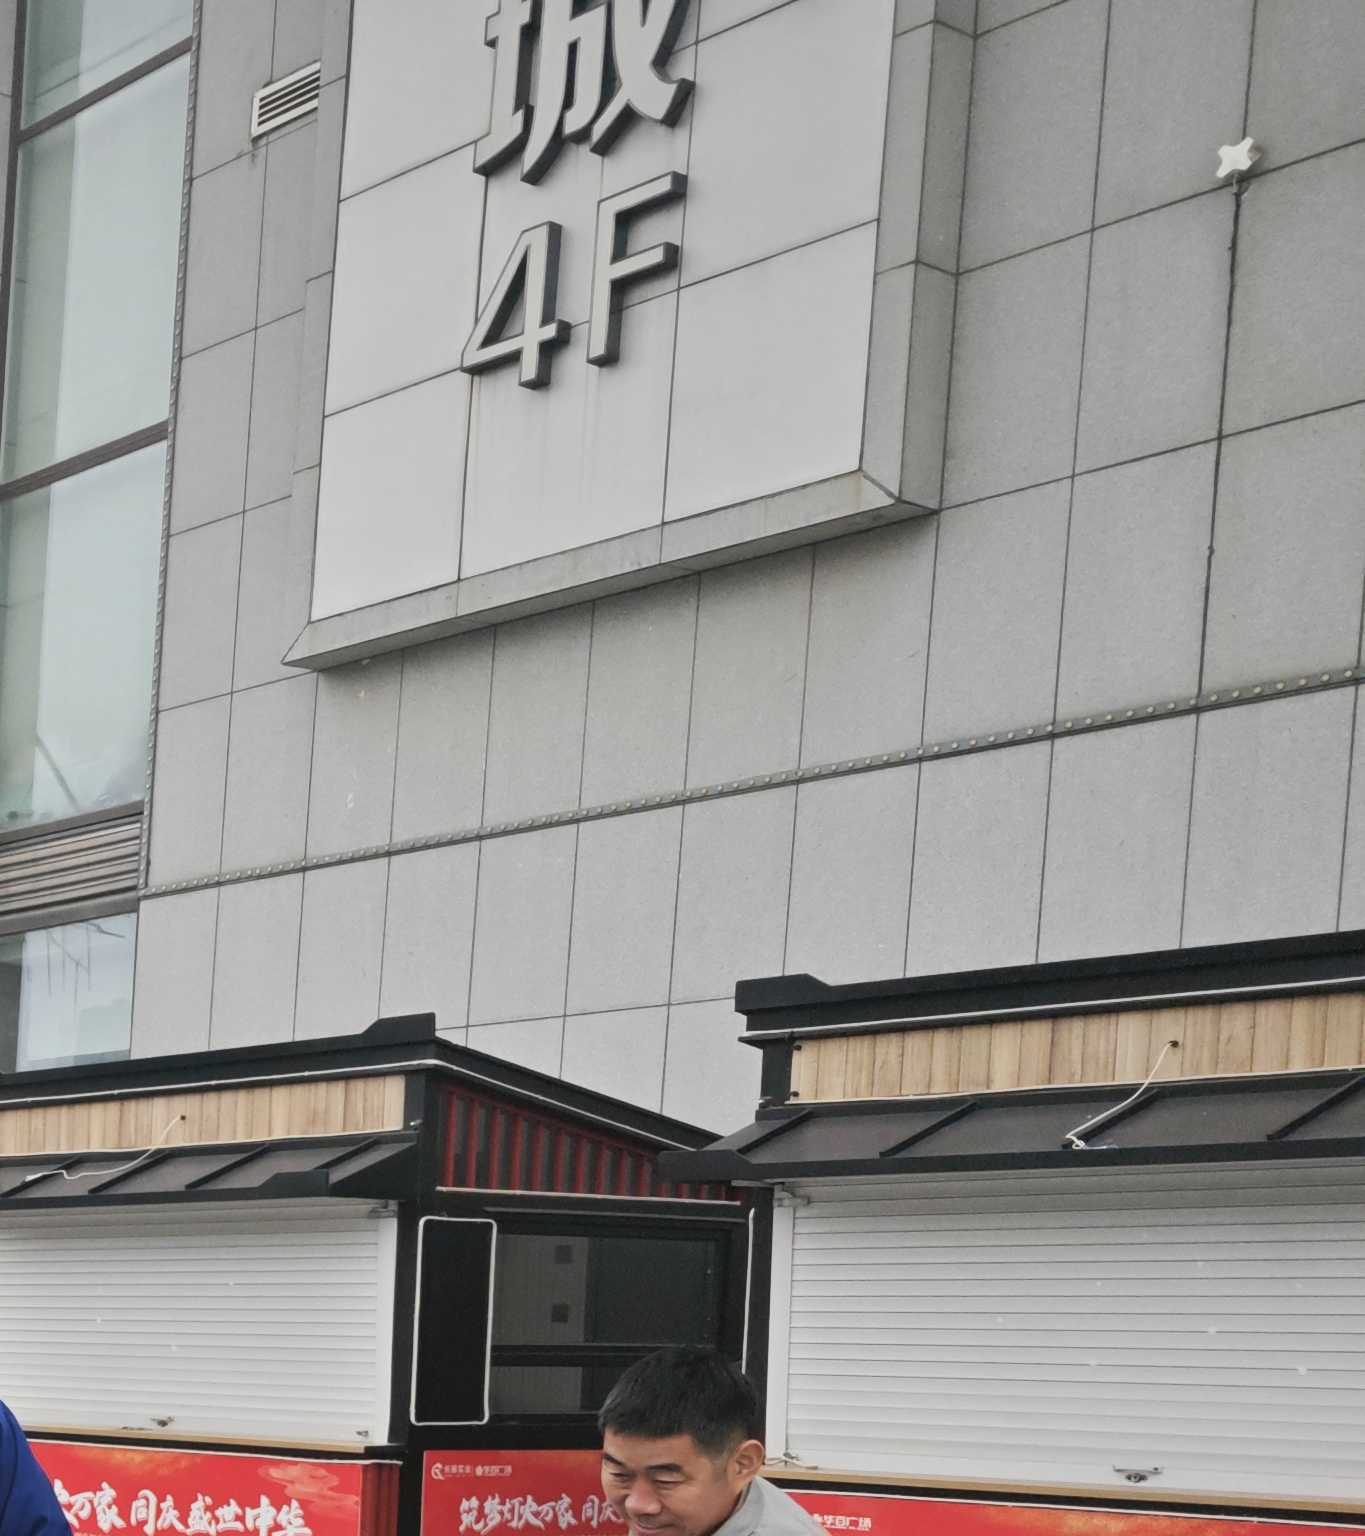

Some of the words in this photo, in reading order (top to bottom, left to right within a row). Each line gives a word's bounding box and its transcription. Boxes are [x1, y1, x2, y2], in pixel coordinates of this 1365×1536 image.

[460, 170, 688, 390] 4F
[458, 1493, 579, 1536] 筑梦灯火万家
